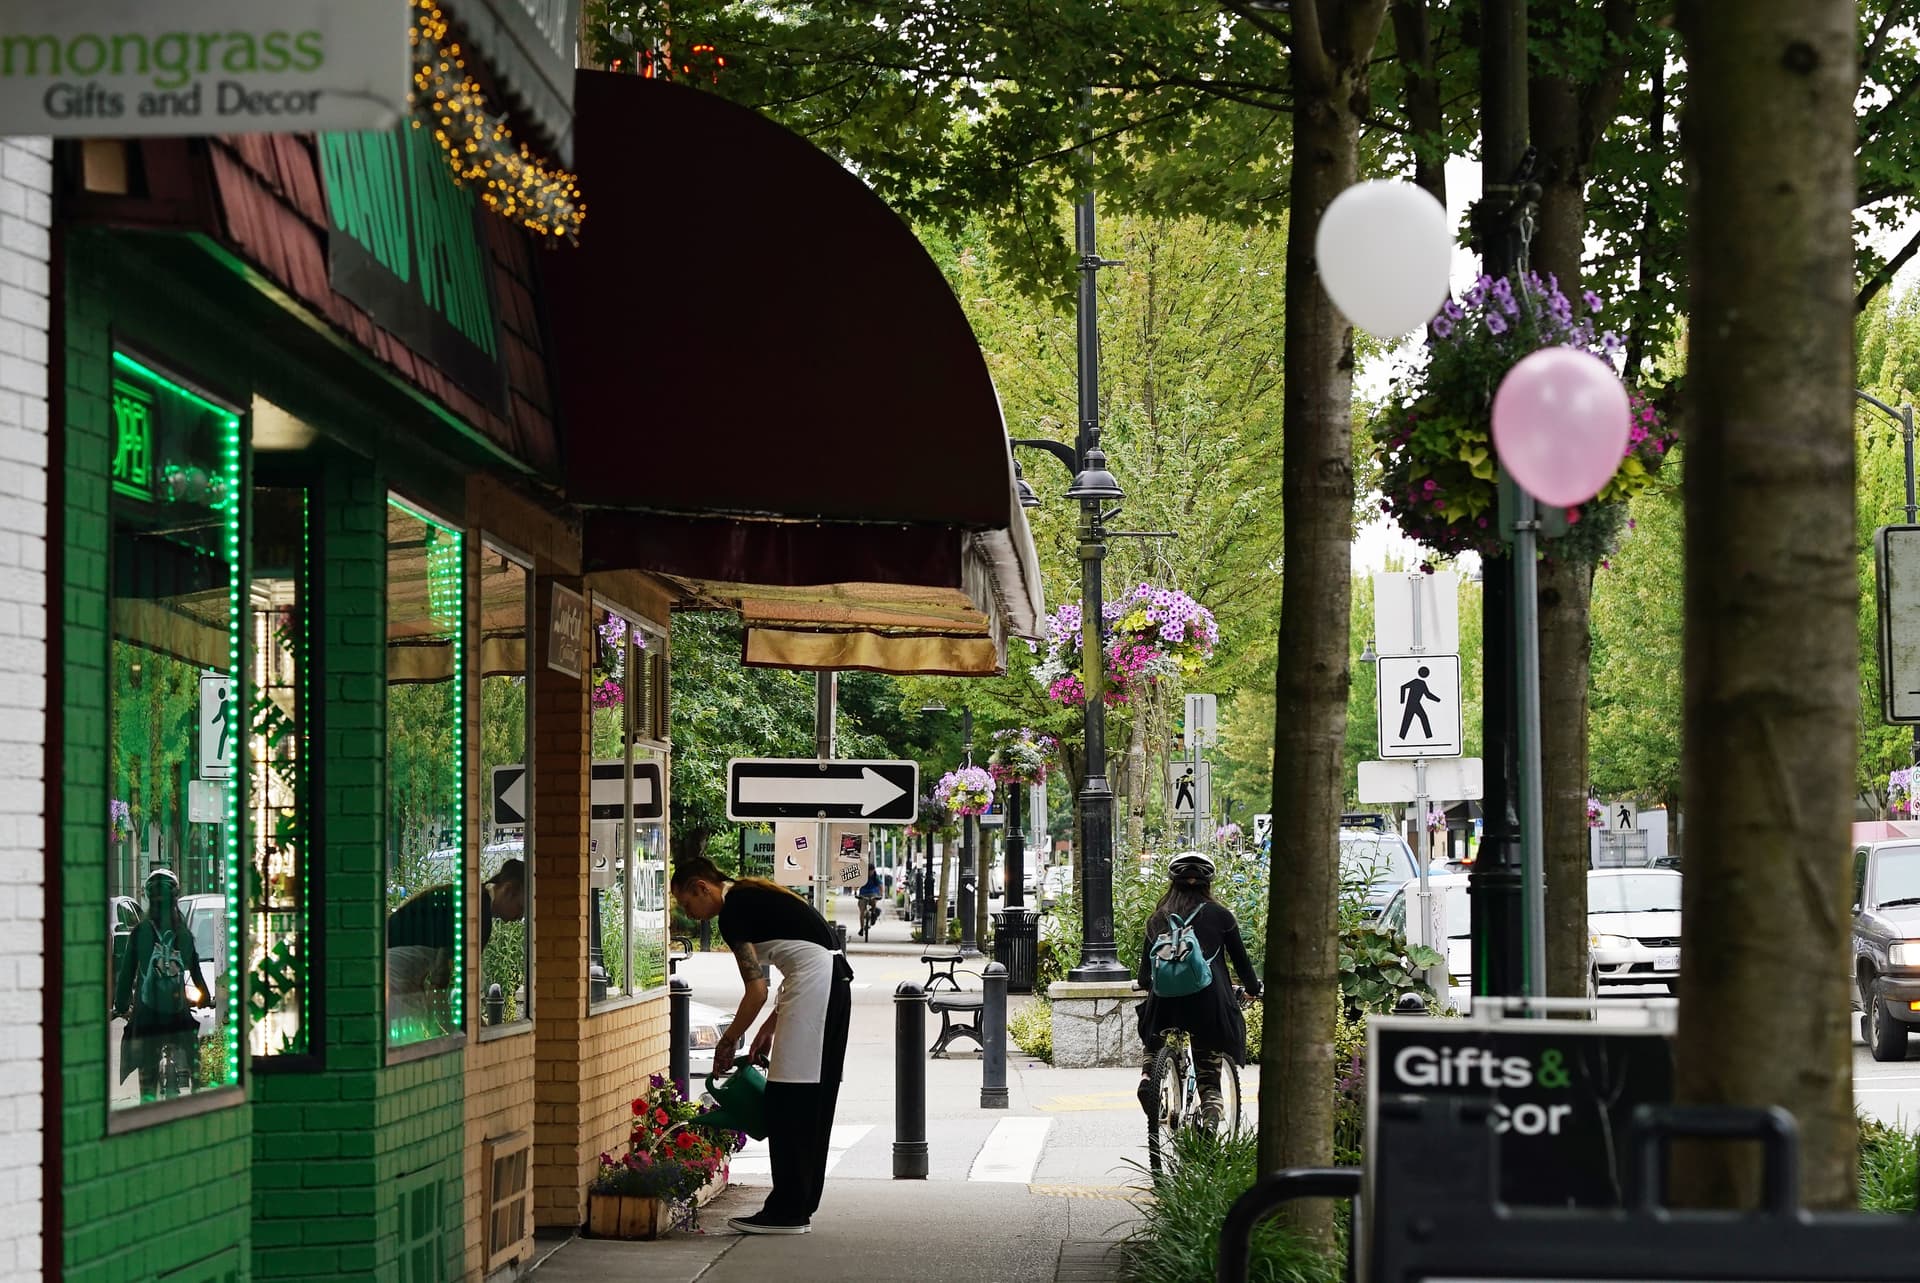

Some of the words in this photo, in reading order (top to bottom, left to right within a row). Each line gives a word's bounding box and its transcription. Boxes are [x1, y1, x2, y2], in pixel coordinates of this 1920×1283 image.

[1, 30, 324, 89] mongrass
[43, 82, 126, 119] Gifts
[138, 81, 200, 117] and
[216, 80, 323, 116] Decor
[1486, 1103, 1572, 1135] cor
